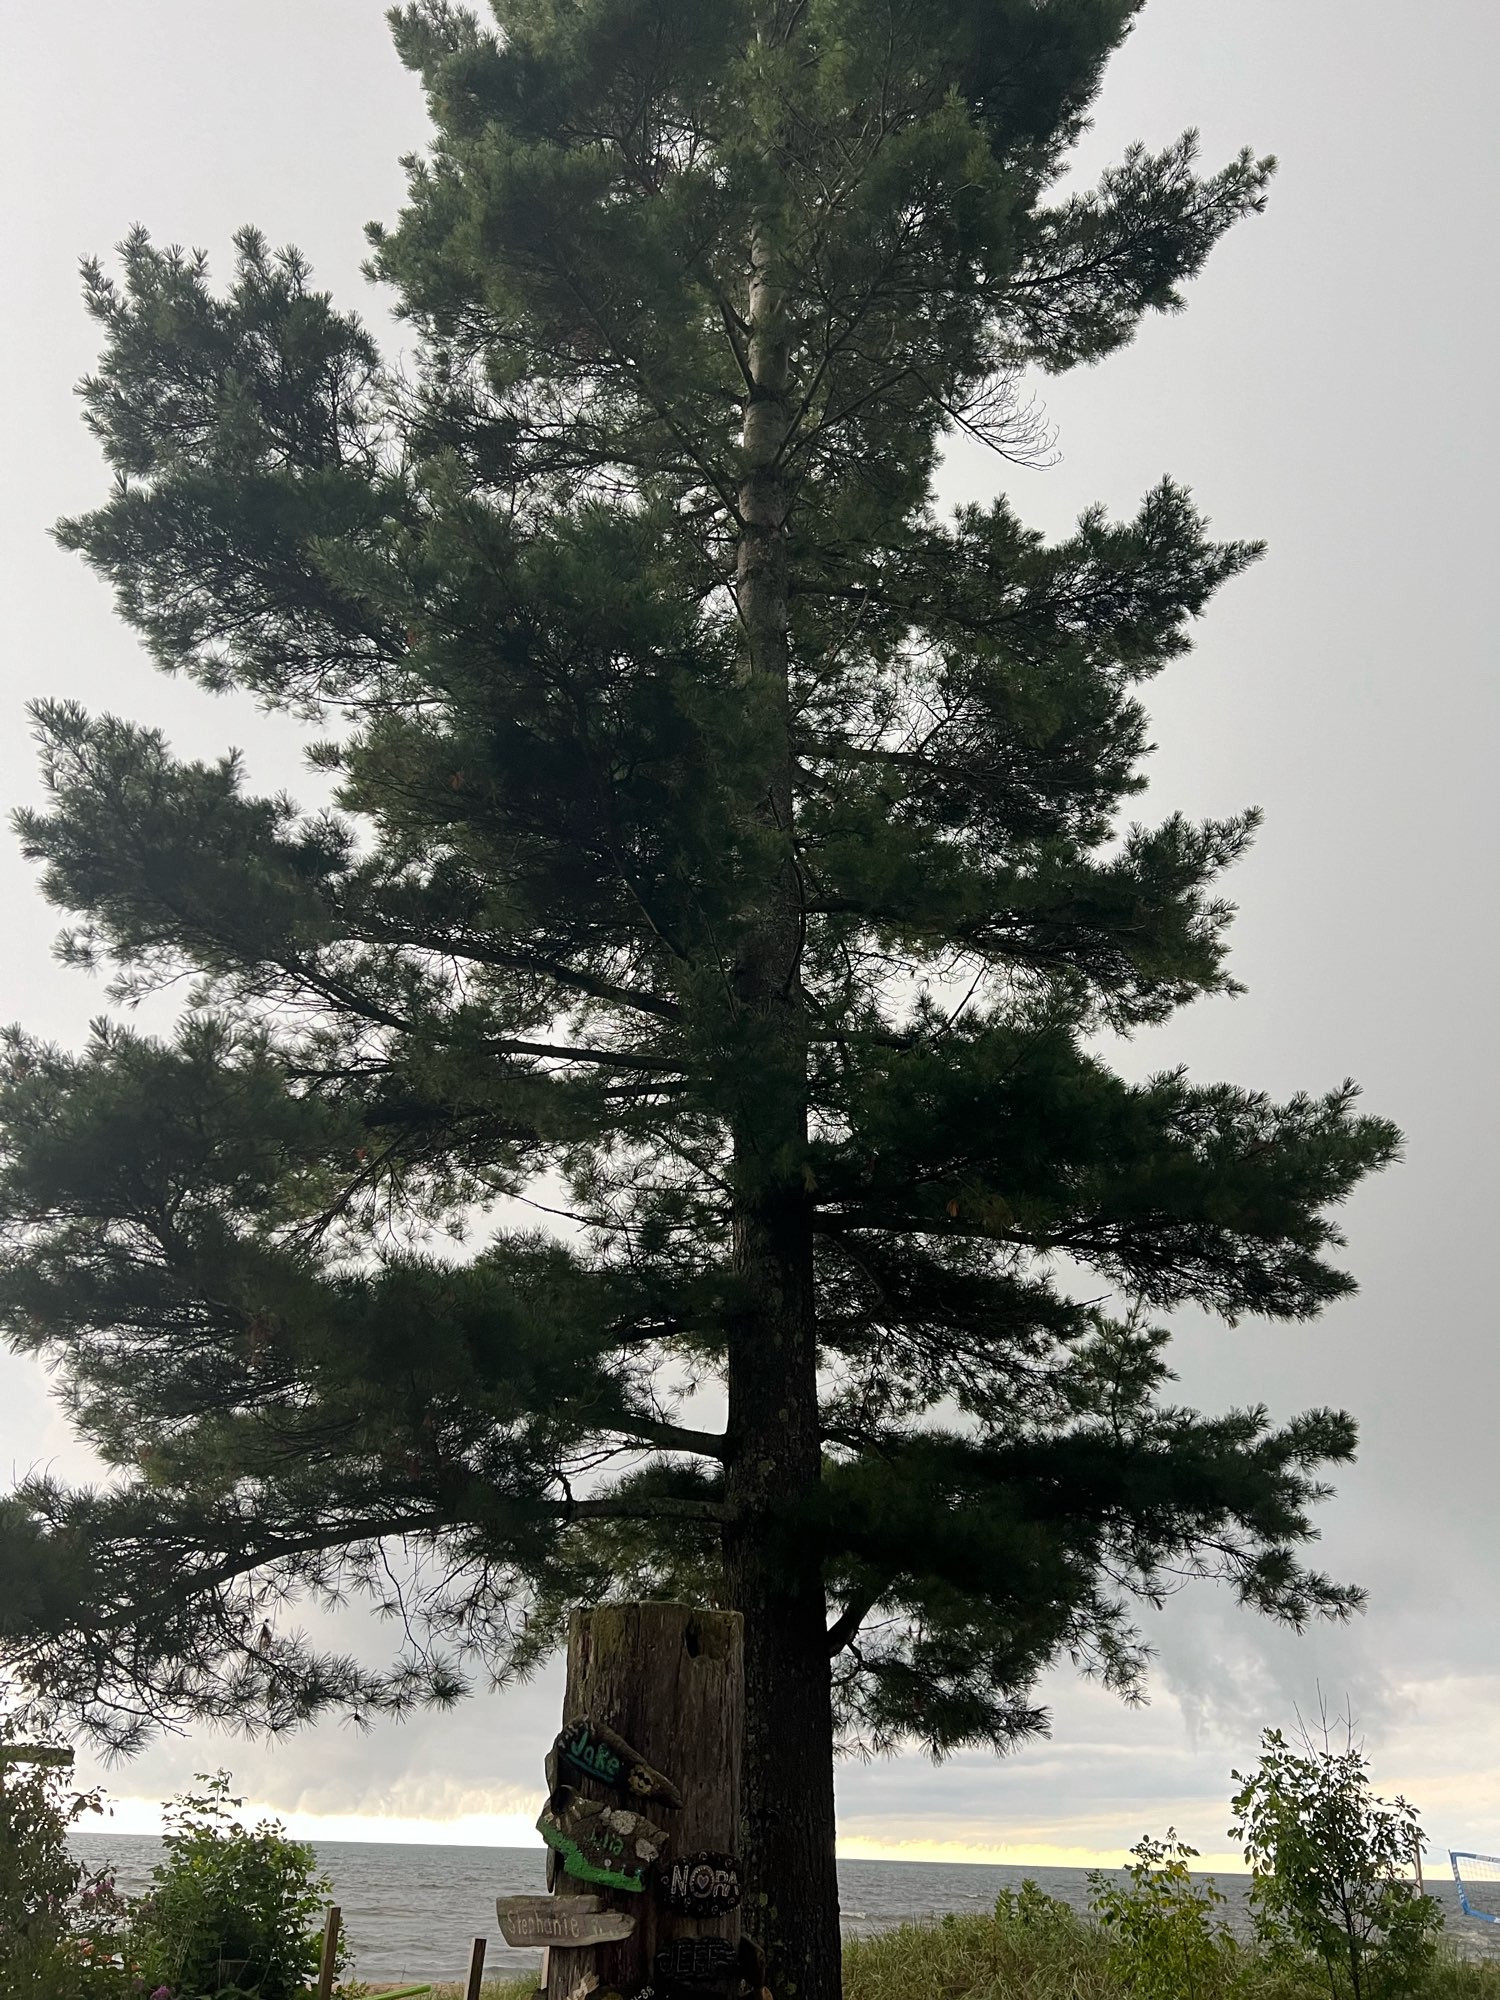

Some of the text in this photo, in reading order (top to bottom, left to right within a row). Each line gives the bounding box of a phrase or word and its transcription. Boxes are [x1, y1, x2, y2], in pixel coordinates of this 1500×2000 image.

[569, 1731, 620, 1775] Jake
[670, 1864, 739, 1898] NORA
[507, 1910, 580, 1938] Stephanie
